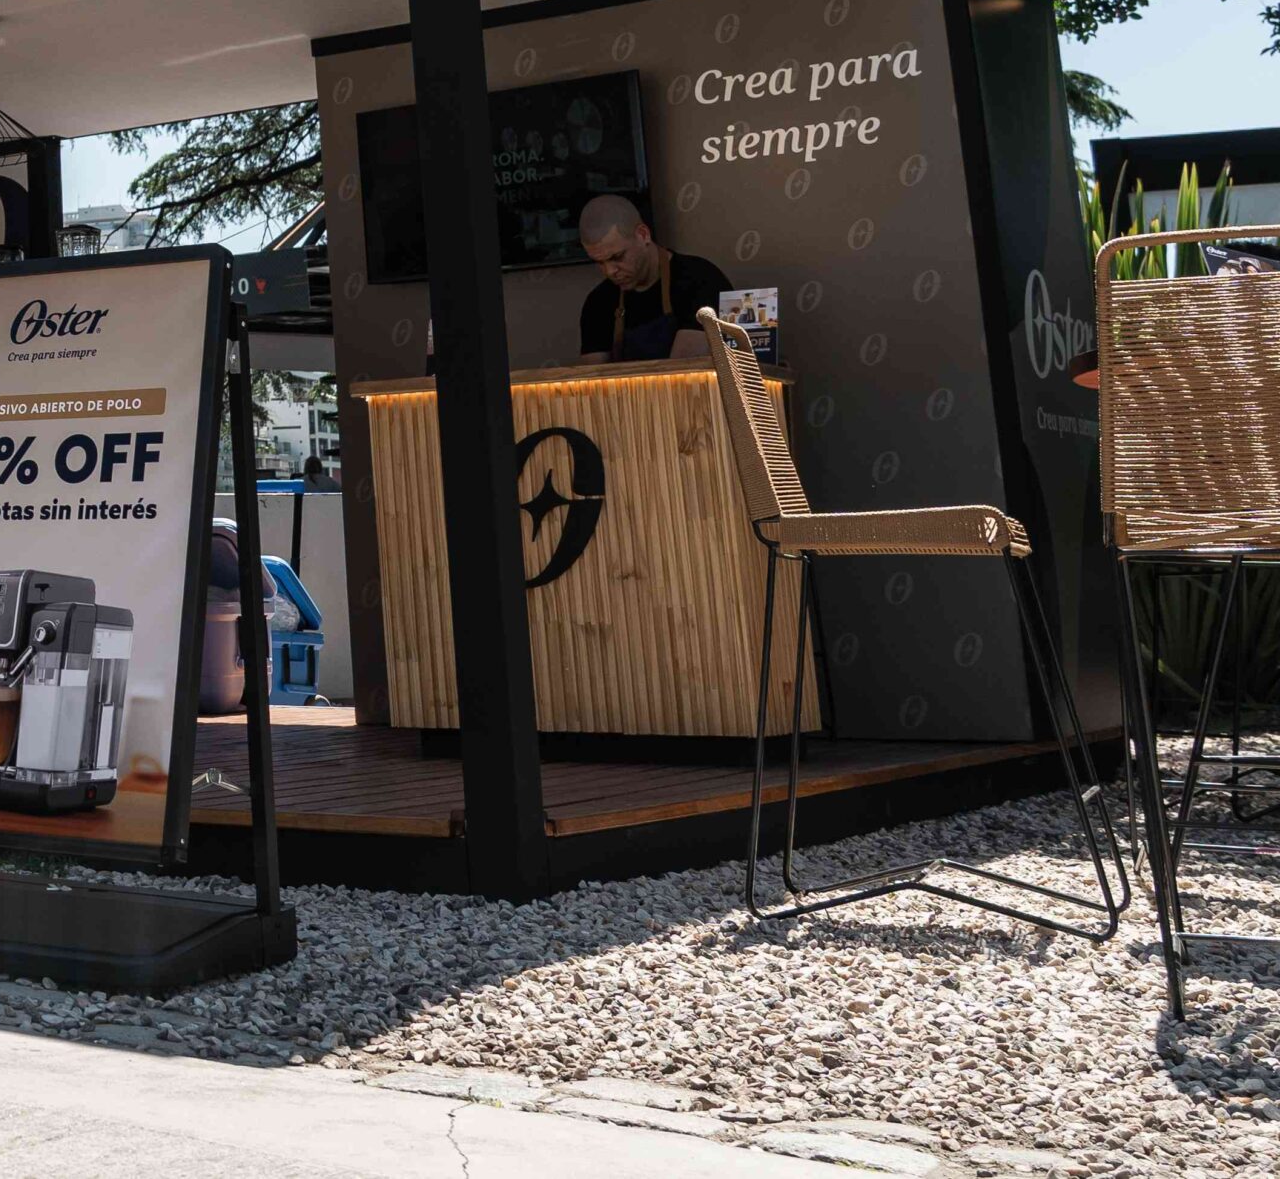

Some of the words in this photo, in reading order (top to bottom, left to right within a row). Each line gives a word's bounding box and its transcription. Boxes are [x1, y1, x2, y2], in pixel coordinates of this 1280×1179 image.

[694, 67, 796, 105] Crea
[809, 49, 922, 102] para
[701, 116, 881, 163] siempre
[10, 299, 109, 345] Oster
[7, 351, 29, 363] Crea
[31, 349, 55, 363] para
[57, 347, 98, 361] siempre
[30, 400, 84, 415] ABIERTO
[87, 399, 103, 412] DE
[107, 398, 142, 411] POLO
[54, 431, 164, 484] OFF
[40, 499, 71, 520] sin
[78, 497, 157, 520] interés
